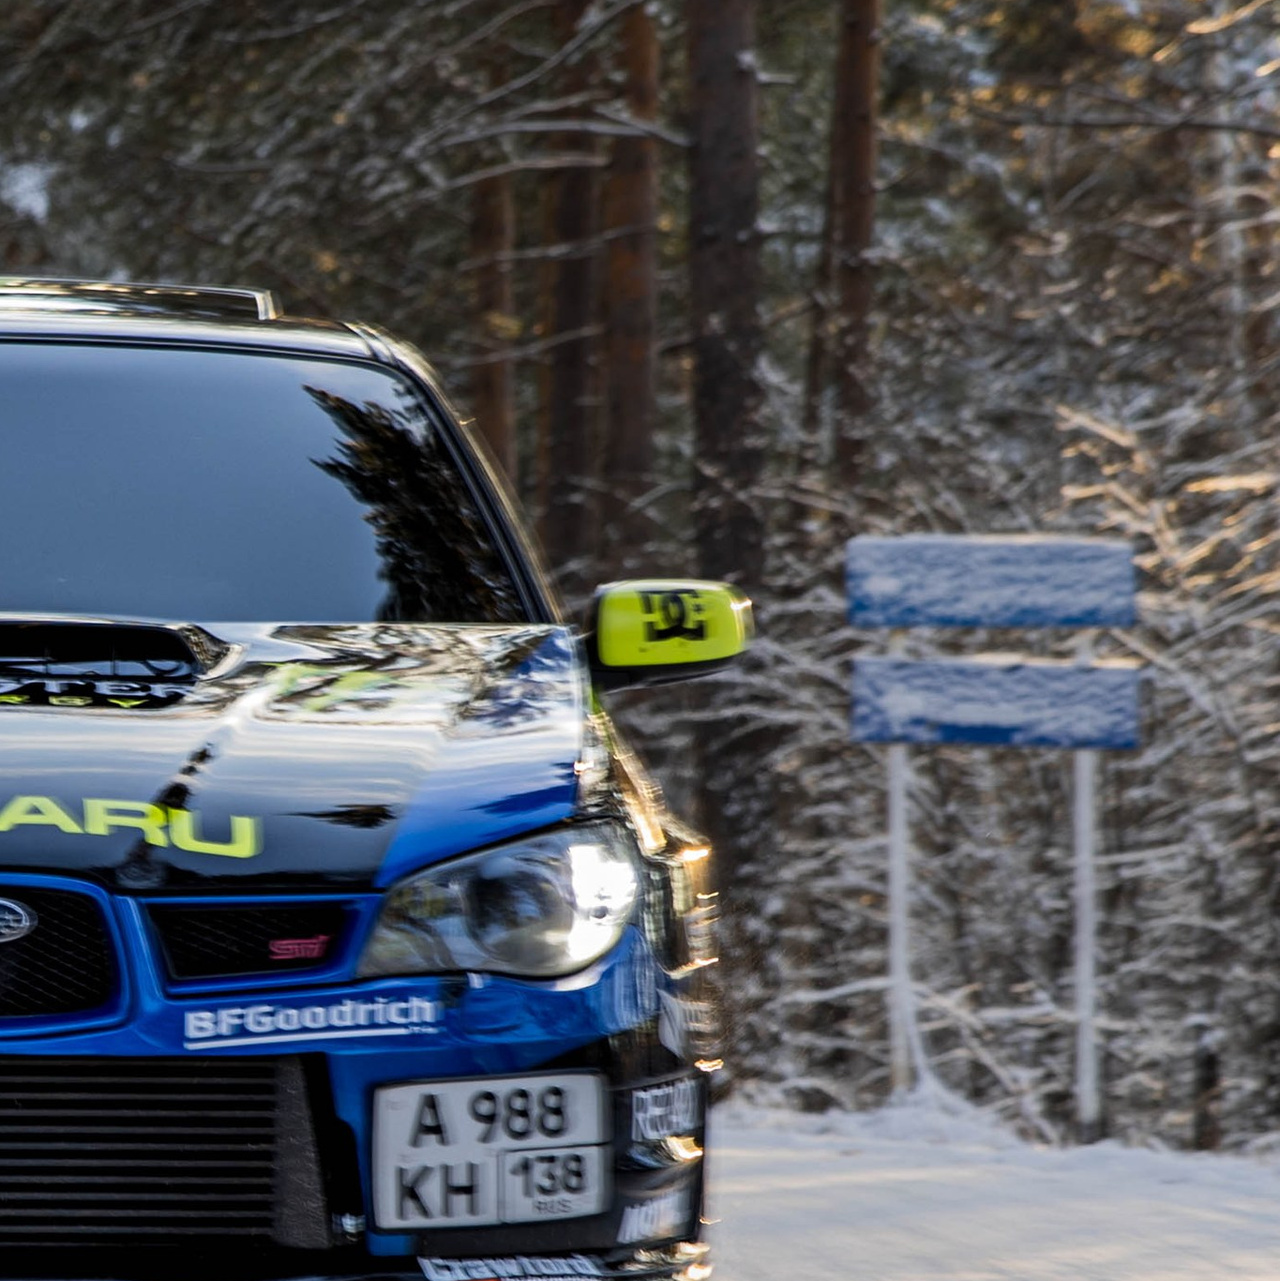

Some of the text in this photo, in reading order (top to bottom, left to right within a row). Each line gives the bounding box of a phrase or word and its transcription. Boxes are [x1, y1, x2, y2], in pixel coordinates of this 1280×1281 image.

[184, 996, 440, 1039] BFGoodrich
[407, 1093, 452, 1148] A
[467, 1086, 568, 1144] 988
[509, 1153, 586, 1198] 138
